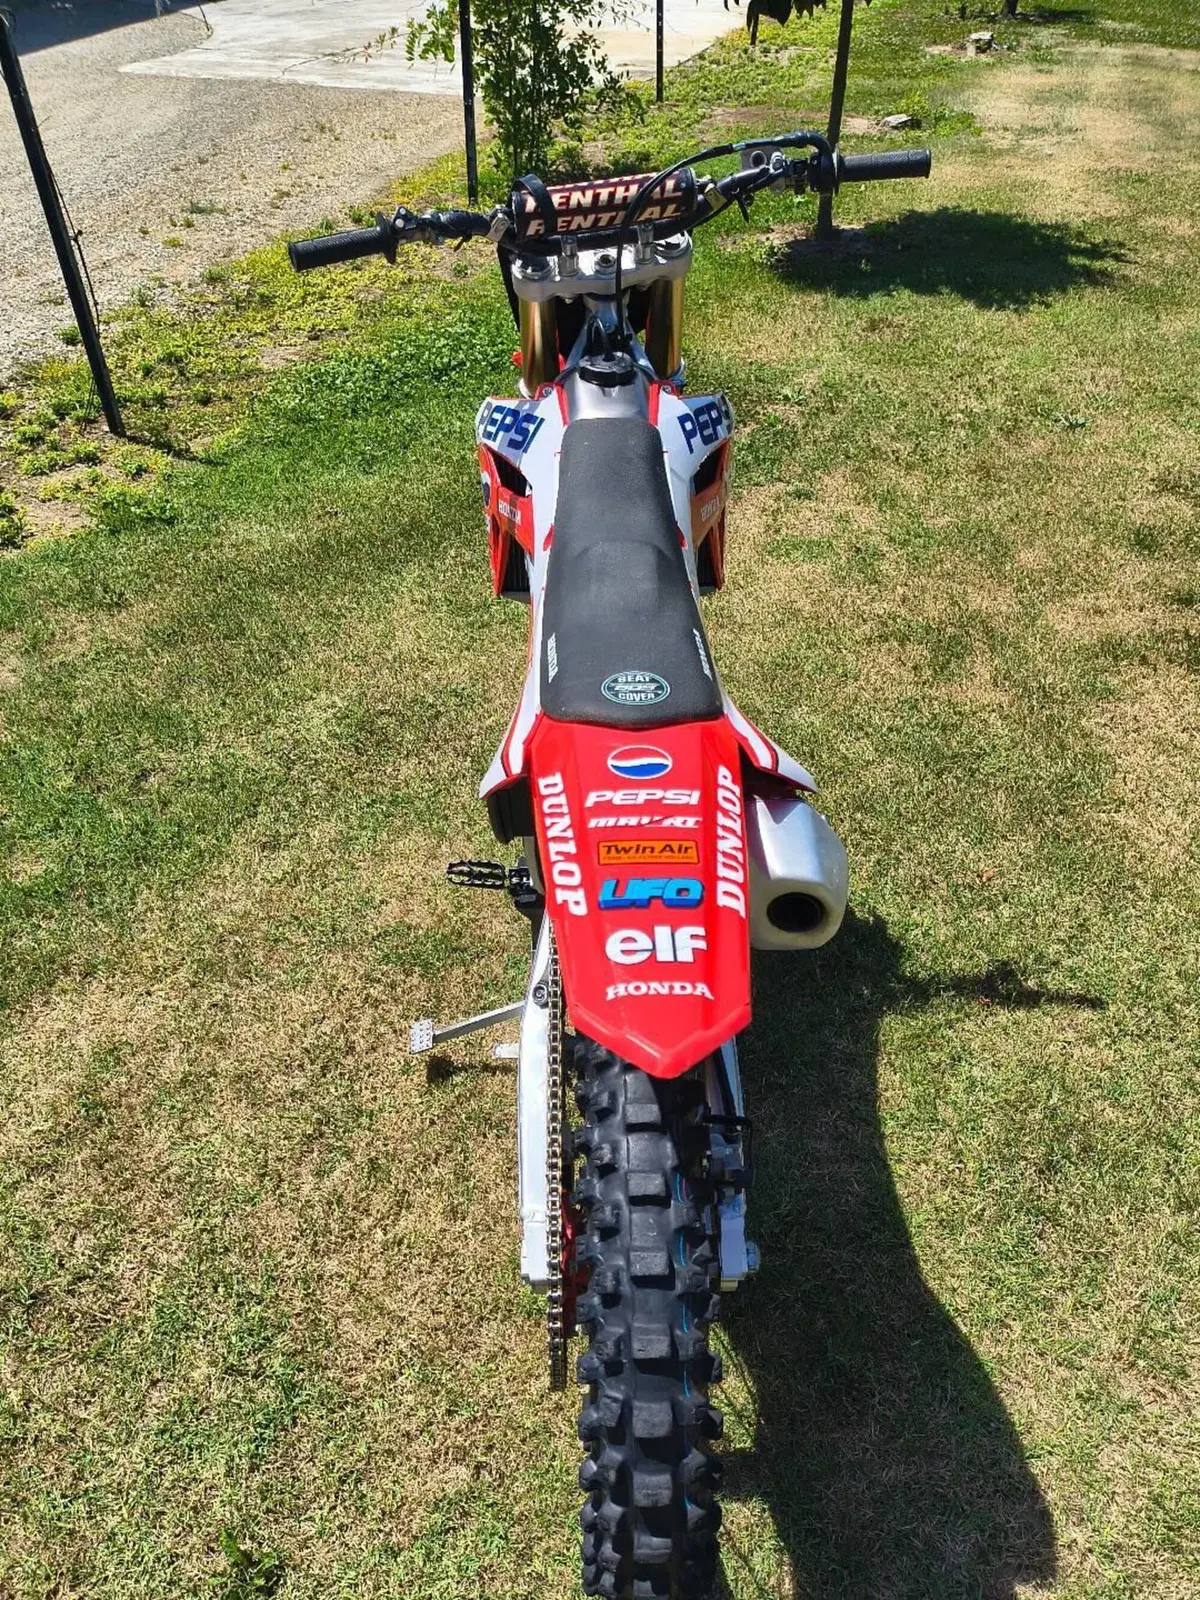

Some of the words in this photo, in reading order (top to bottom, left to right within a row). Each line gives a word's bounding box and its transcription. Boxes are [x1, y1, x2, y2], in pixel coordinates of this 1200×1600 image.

[478, 400, 546, 454] PEPSI
[618, 692, 656, 702] COVER
[584, 789, 701, 808] PEPSI
[538, 772, 588, 916] DUNLOP
[602, 844, 655, 855] Twin
[660, 844, 693, 855] Air
[716, 765, 746, 919] DUNLOP
[599, 878, 704, 910] UFO
[605, 925, 707, 965] elf
[605, 981, 715, 1001] HONDA
